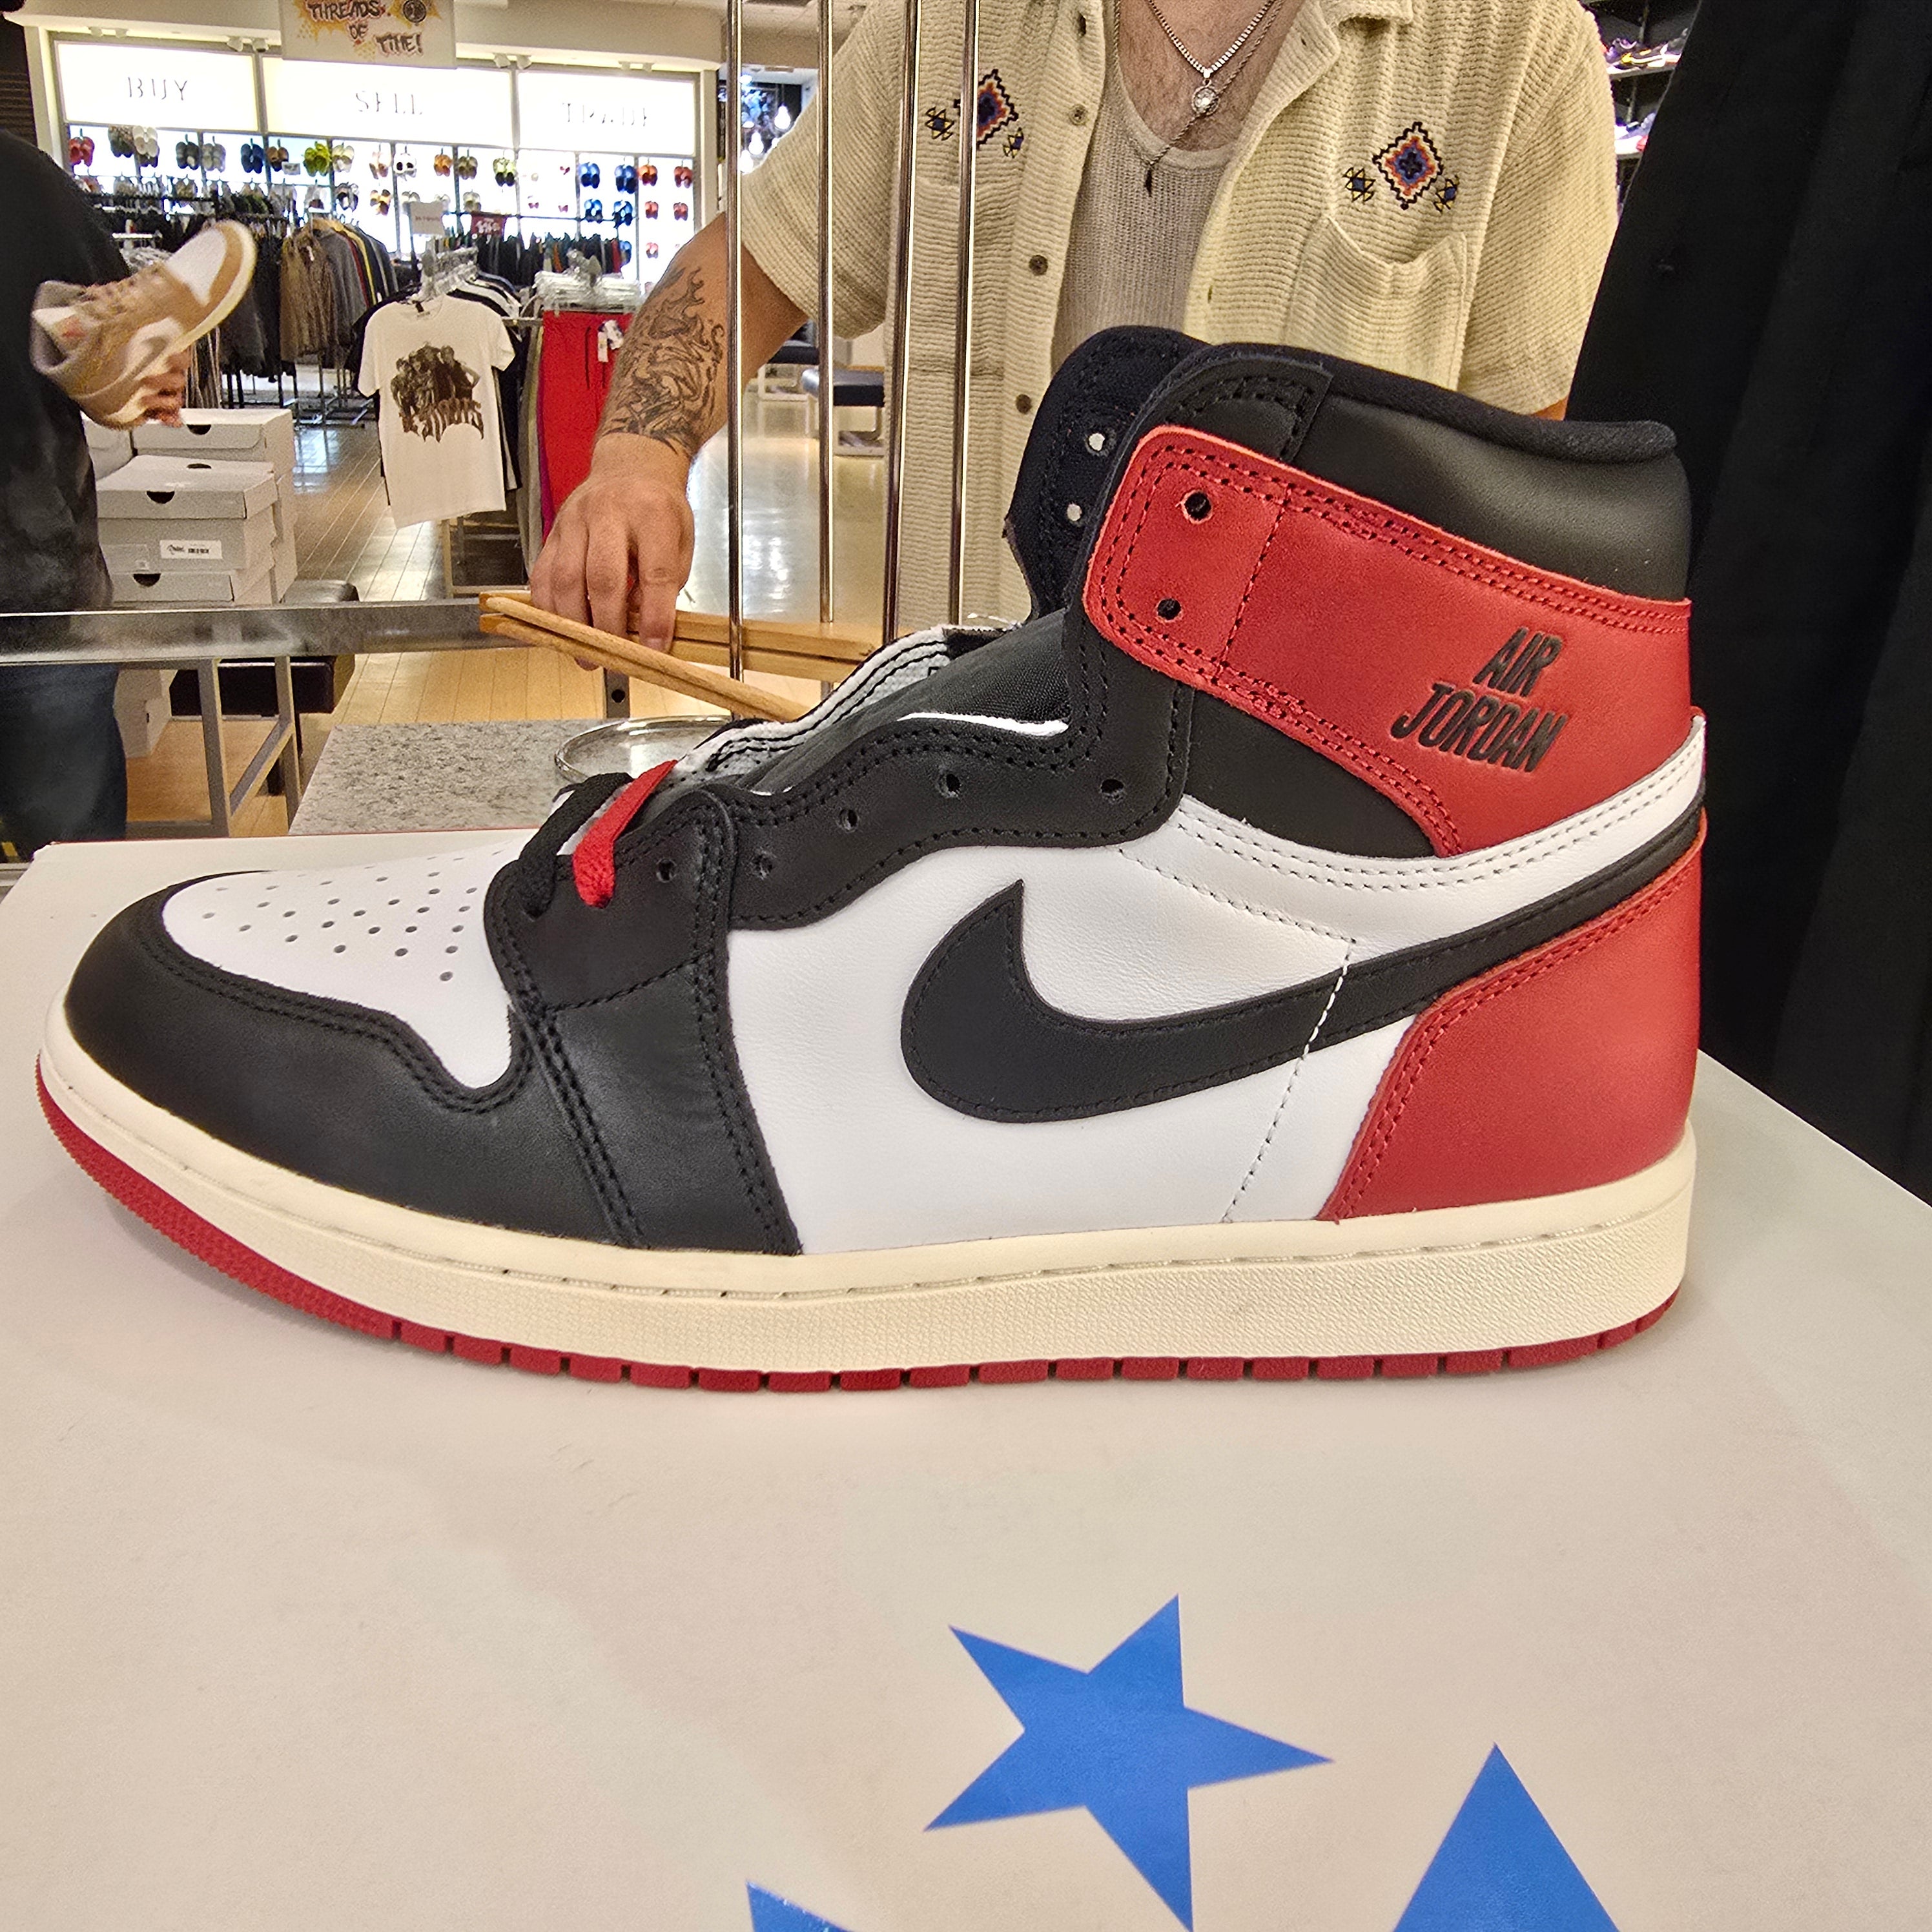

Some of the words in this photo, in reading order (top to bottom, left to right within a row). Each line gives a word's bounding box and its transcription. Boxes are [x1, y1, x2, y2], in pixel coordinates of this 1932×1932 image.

[307, 0, 381, 21] THREADS
[348, 23, 368, 39] OF
[375, 33, 422, 54] TIME!
[128, 77, 188, 101] BUY
[355, 90, 423, 115] SELL
[1472, 627, 1563, 697] AIR
[1390, 682, 1568, 773] JORDAN
